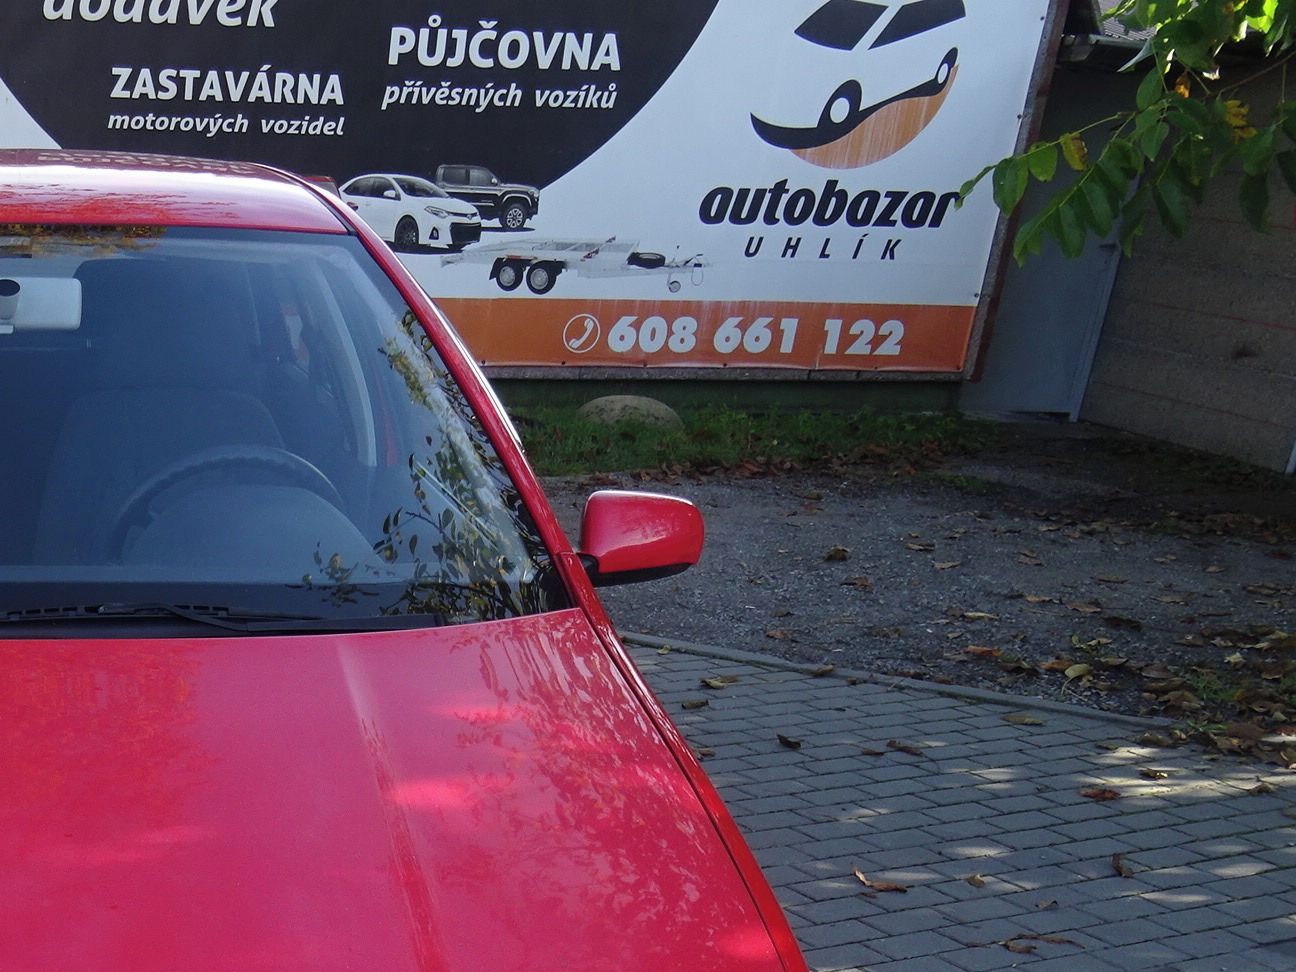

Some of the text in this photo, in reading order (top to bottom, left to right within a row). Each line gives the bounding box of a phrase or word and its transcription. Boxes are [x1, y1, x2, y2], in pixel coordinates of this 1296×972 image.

[388, 14, 621, 71] PŮJČOVNA
[110, 64, 344, 105] ZASTAVÁRNA
[381, 80, 618, 113] přívěsných vozíků
[107, 113, 345, 138] motorových vozidel
[698, 178, 960, 229] autobazar
[744, 233, 903, 261] UHLÍK
[607, 315, 905, 356] 608 661 122
